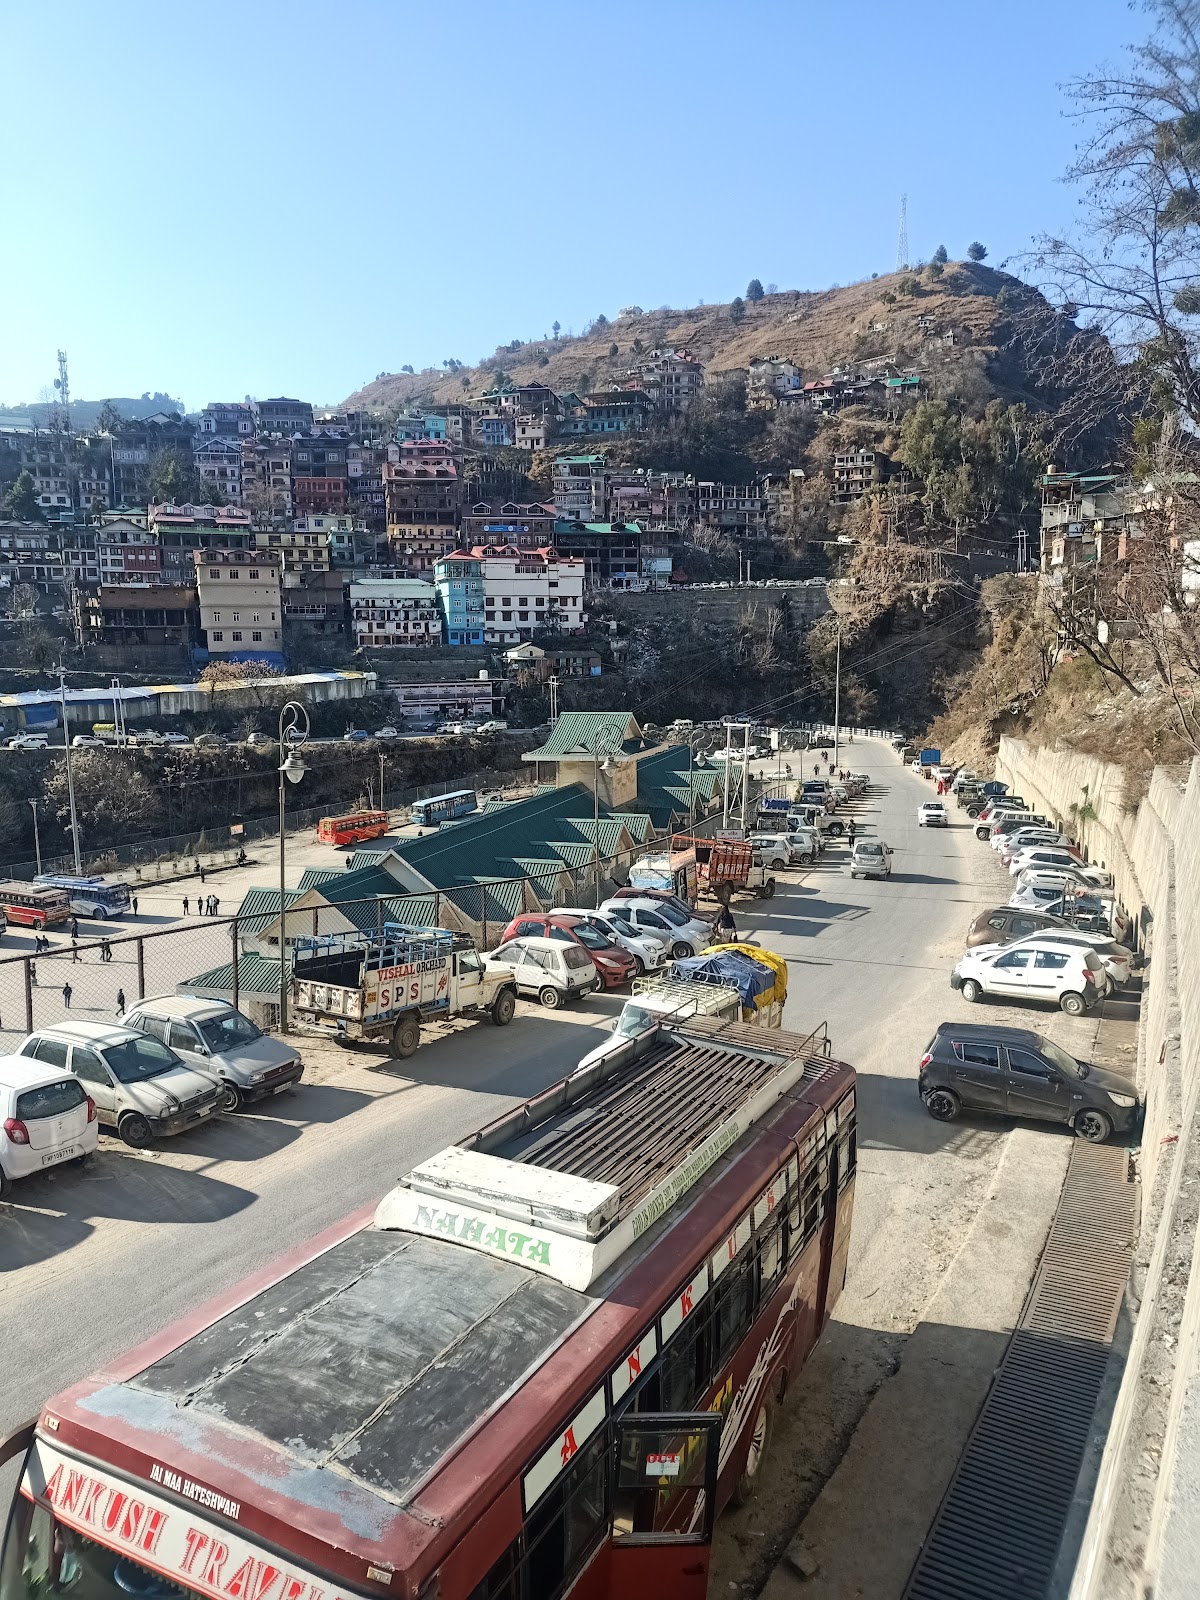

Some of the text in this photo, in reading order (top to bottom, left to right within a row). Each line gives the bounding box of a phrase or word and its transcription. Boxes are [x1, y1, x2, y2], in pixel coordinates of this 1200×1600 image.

[377, 963, 416, 982] VISHAL
[416, 957, 447, 974] ORCHARD
[381, 989, 390, 1008] S
[395, 986, 404, 1003] P
[410, 982, 419, 1001] S
[412, 1205, 551, 1266] NAHATA
[561, 1424, 578, 1467] A
[628, 1346, 641, 1385] N
[681, 1284, 693, 1320] K
[728, 1230, 737, 1260] U
[150, 1463, 242, 1520] JAI MAA HATESHWARI
[41, 1463, 347, 1600] ANKUSH TRAVE
